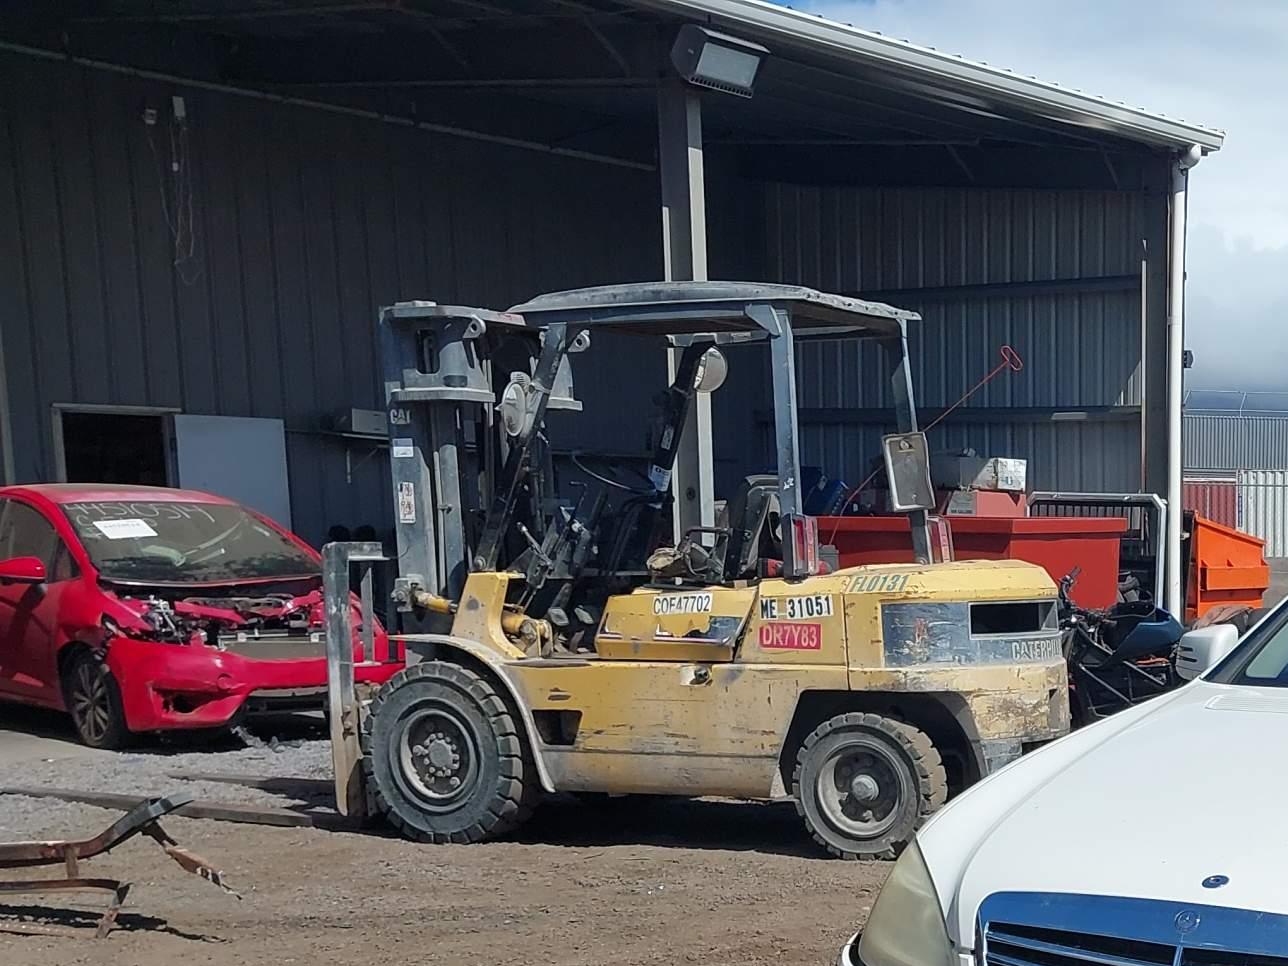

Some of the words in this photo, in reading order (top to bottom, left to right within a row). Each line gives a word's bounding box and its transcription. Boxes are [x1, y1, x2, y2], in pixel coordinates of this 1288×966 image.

[760, 599, 777, 619] ME
[787, 596, 832, 618] 31051
[762, 625, 818, 648] DR7Y83
